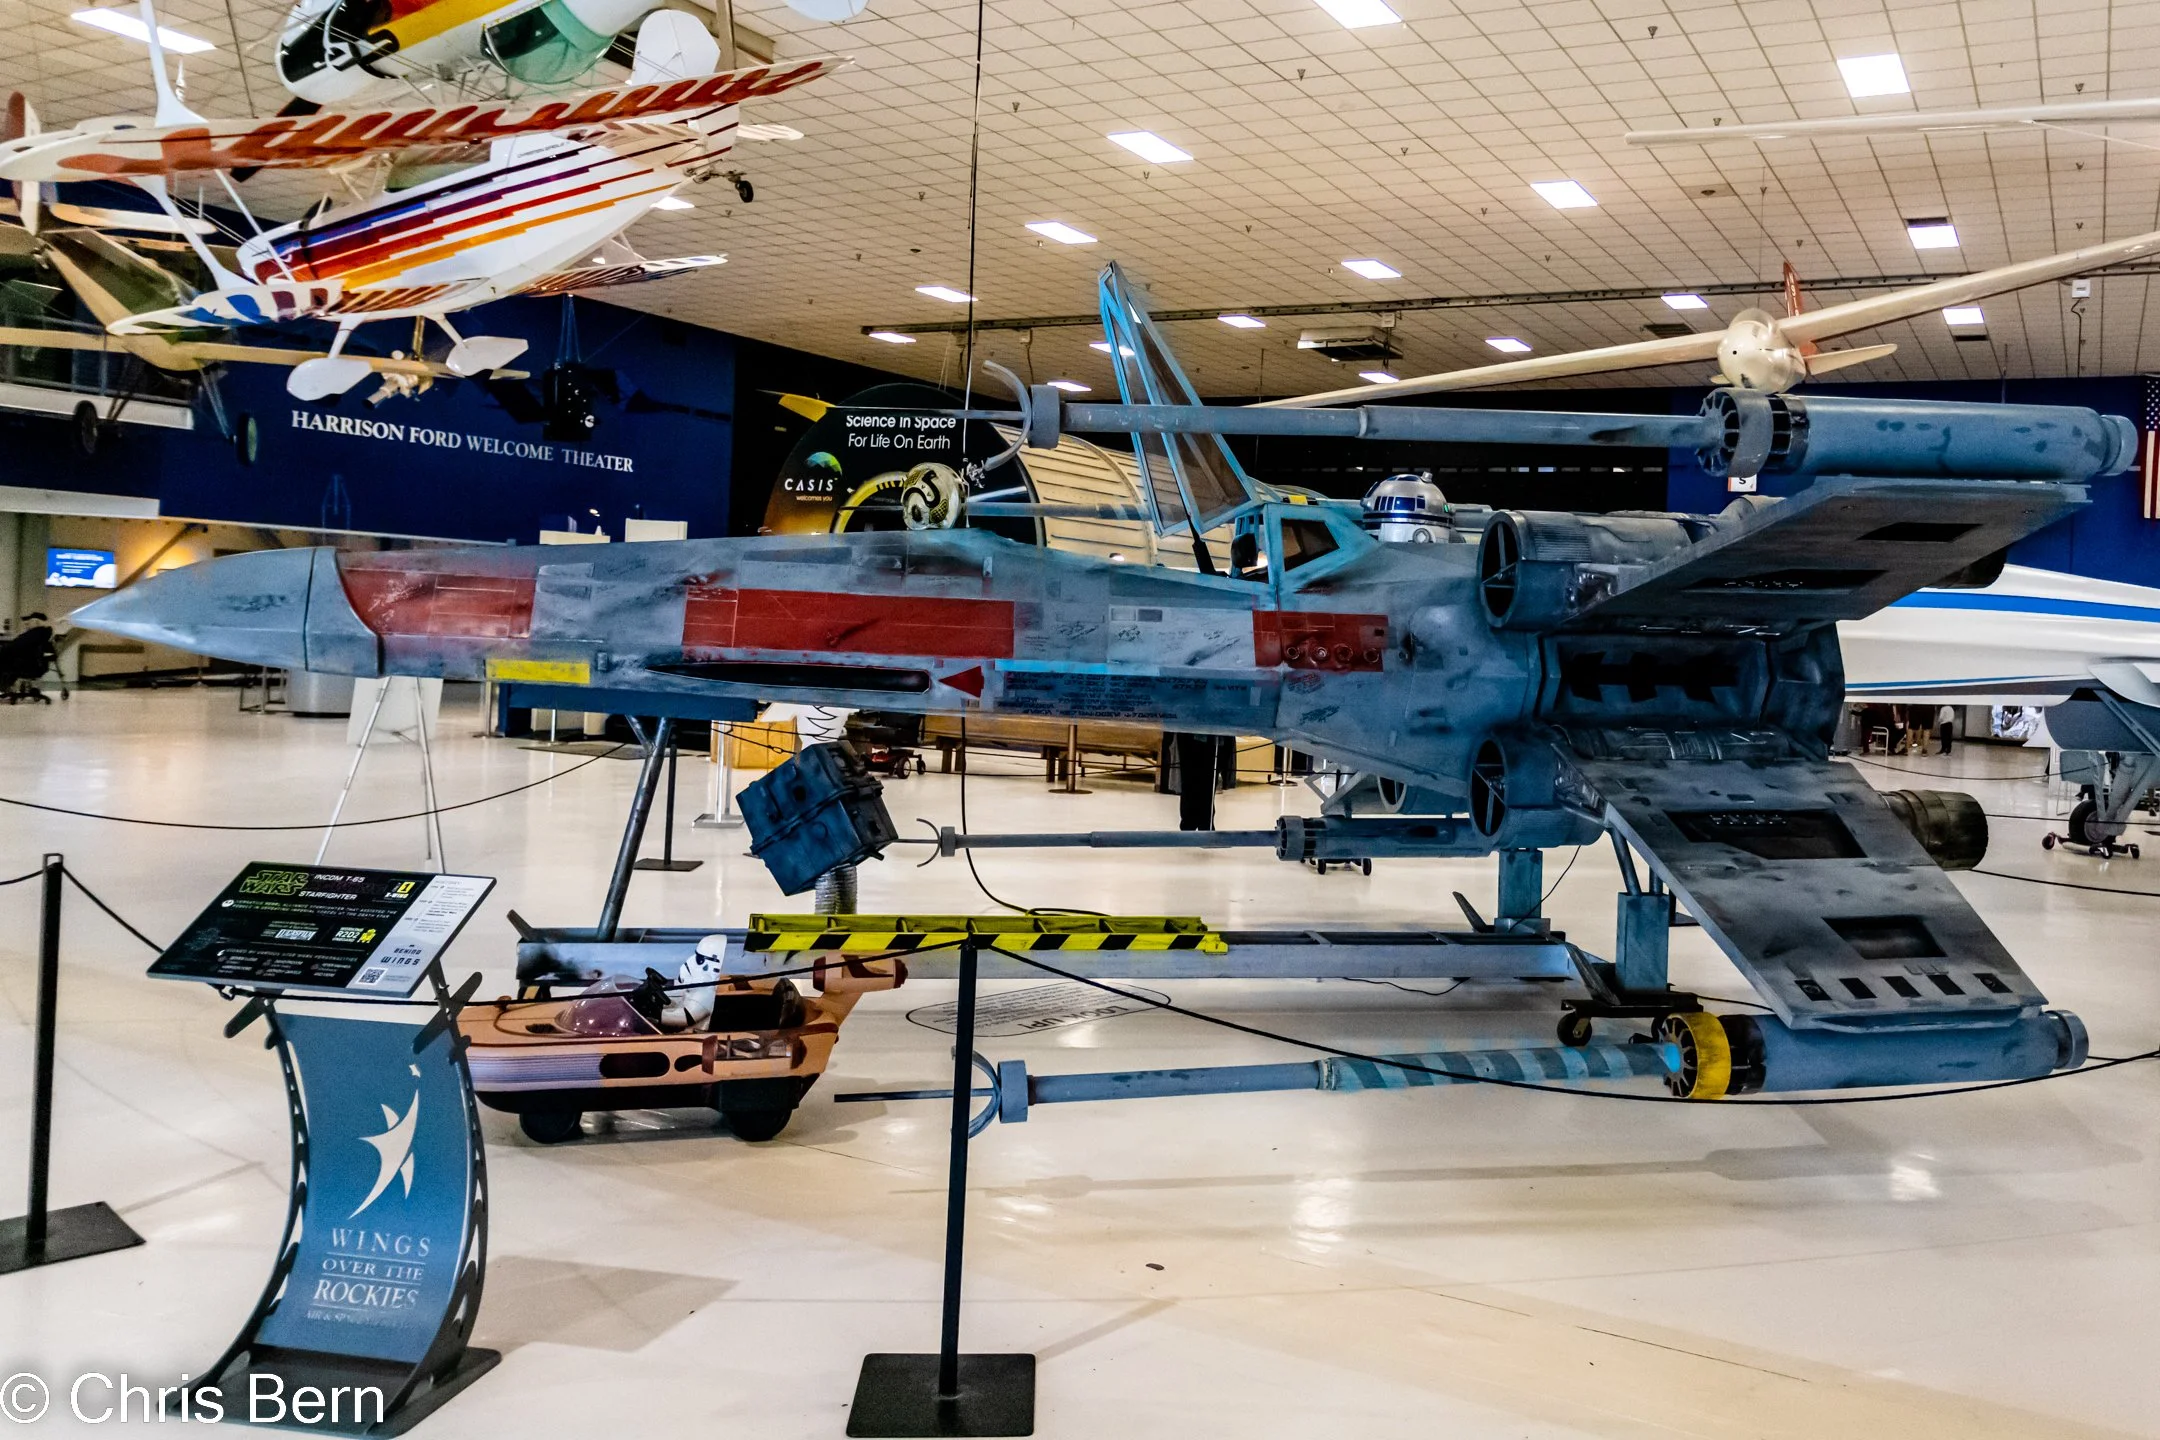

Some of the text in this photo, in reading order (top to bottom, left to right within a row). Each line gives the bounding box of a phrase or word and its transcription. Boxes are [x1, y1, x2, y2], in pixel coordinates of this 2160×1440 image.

[846, 415, 896, 428] Science
[914, 416, 956, 431] Space
[291, 410, 633, 473] HARRISON FORD WELCOME THEATER
[848, 433, 950, 449] For Life On Earth
[784, 478, 834, 491] CASIS
[248, 870, 310, 885] STAR
[314, 874, 366, 883] INCOM T-65
[239, 880, 308, 896] WARS
[298, 890, 358, 900] STARFIGHTER
[335, 930, 361, 939] R2D2
[380, 956, 421, 966] WINGS
[332, 1228, 431, 1257] WINGS
[322, 1258, 424, 1280] OVER THE
[313, 1280, 419, 1309] ROCKIES
